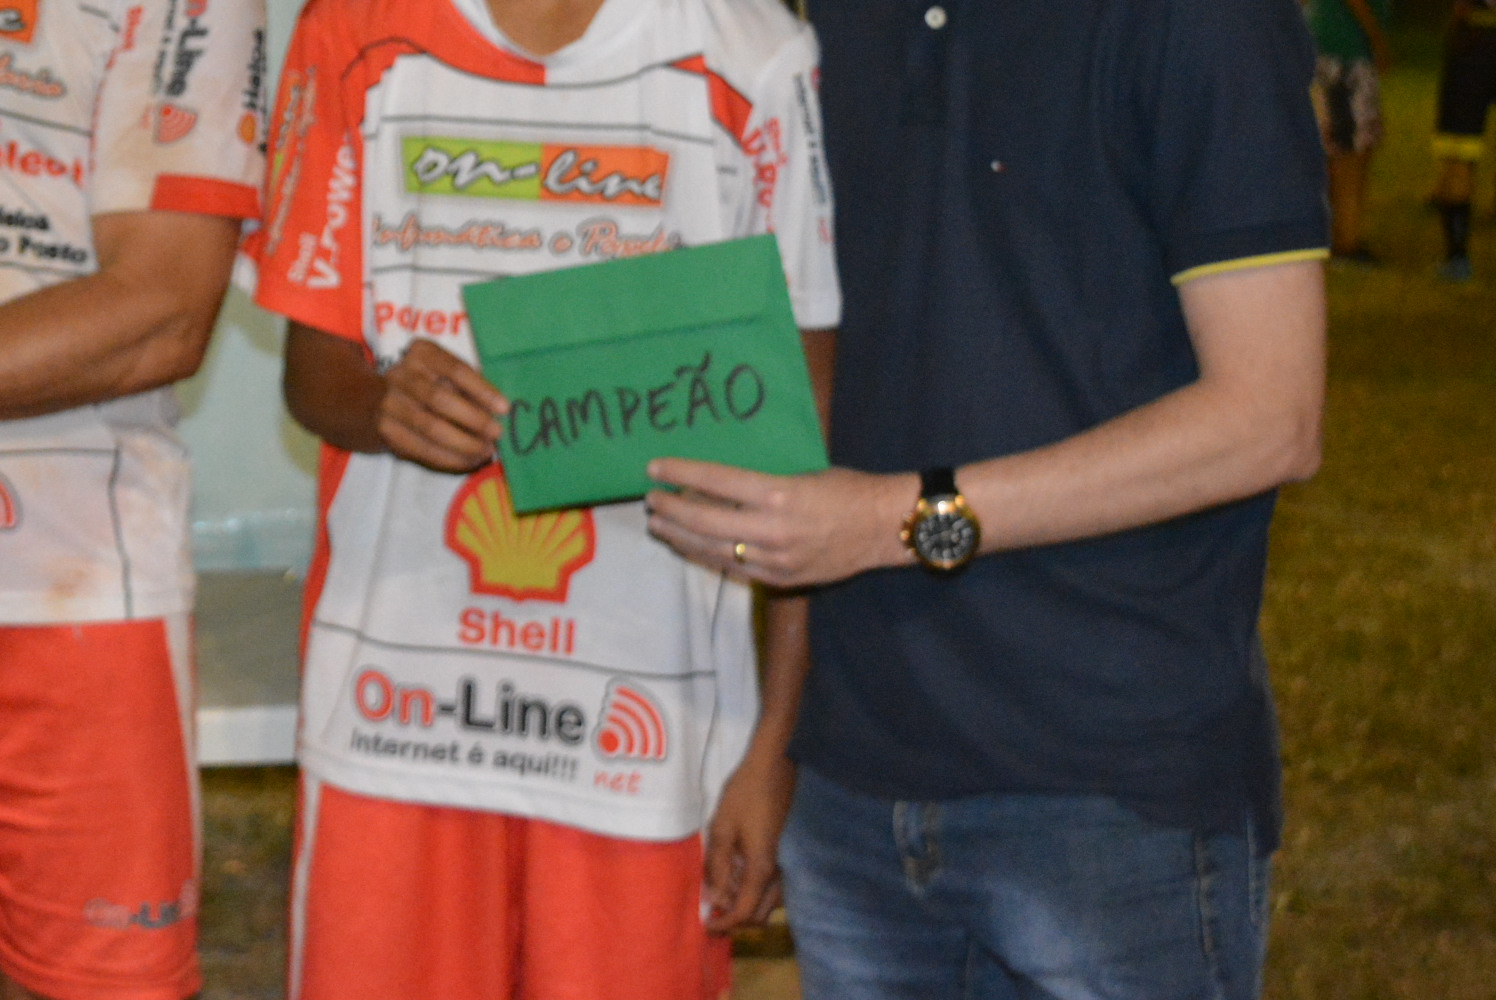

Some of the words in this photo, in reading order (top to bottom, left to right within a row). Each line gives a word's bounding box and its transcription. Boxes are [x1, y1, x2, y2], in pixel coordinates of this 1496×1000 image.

[509, 350, 765, 456] CAMPEÃO
[458, 606, 575, 655] Shell
[356, 668, 585, 745] On-Line
